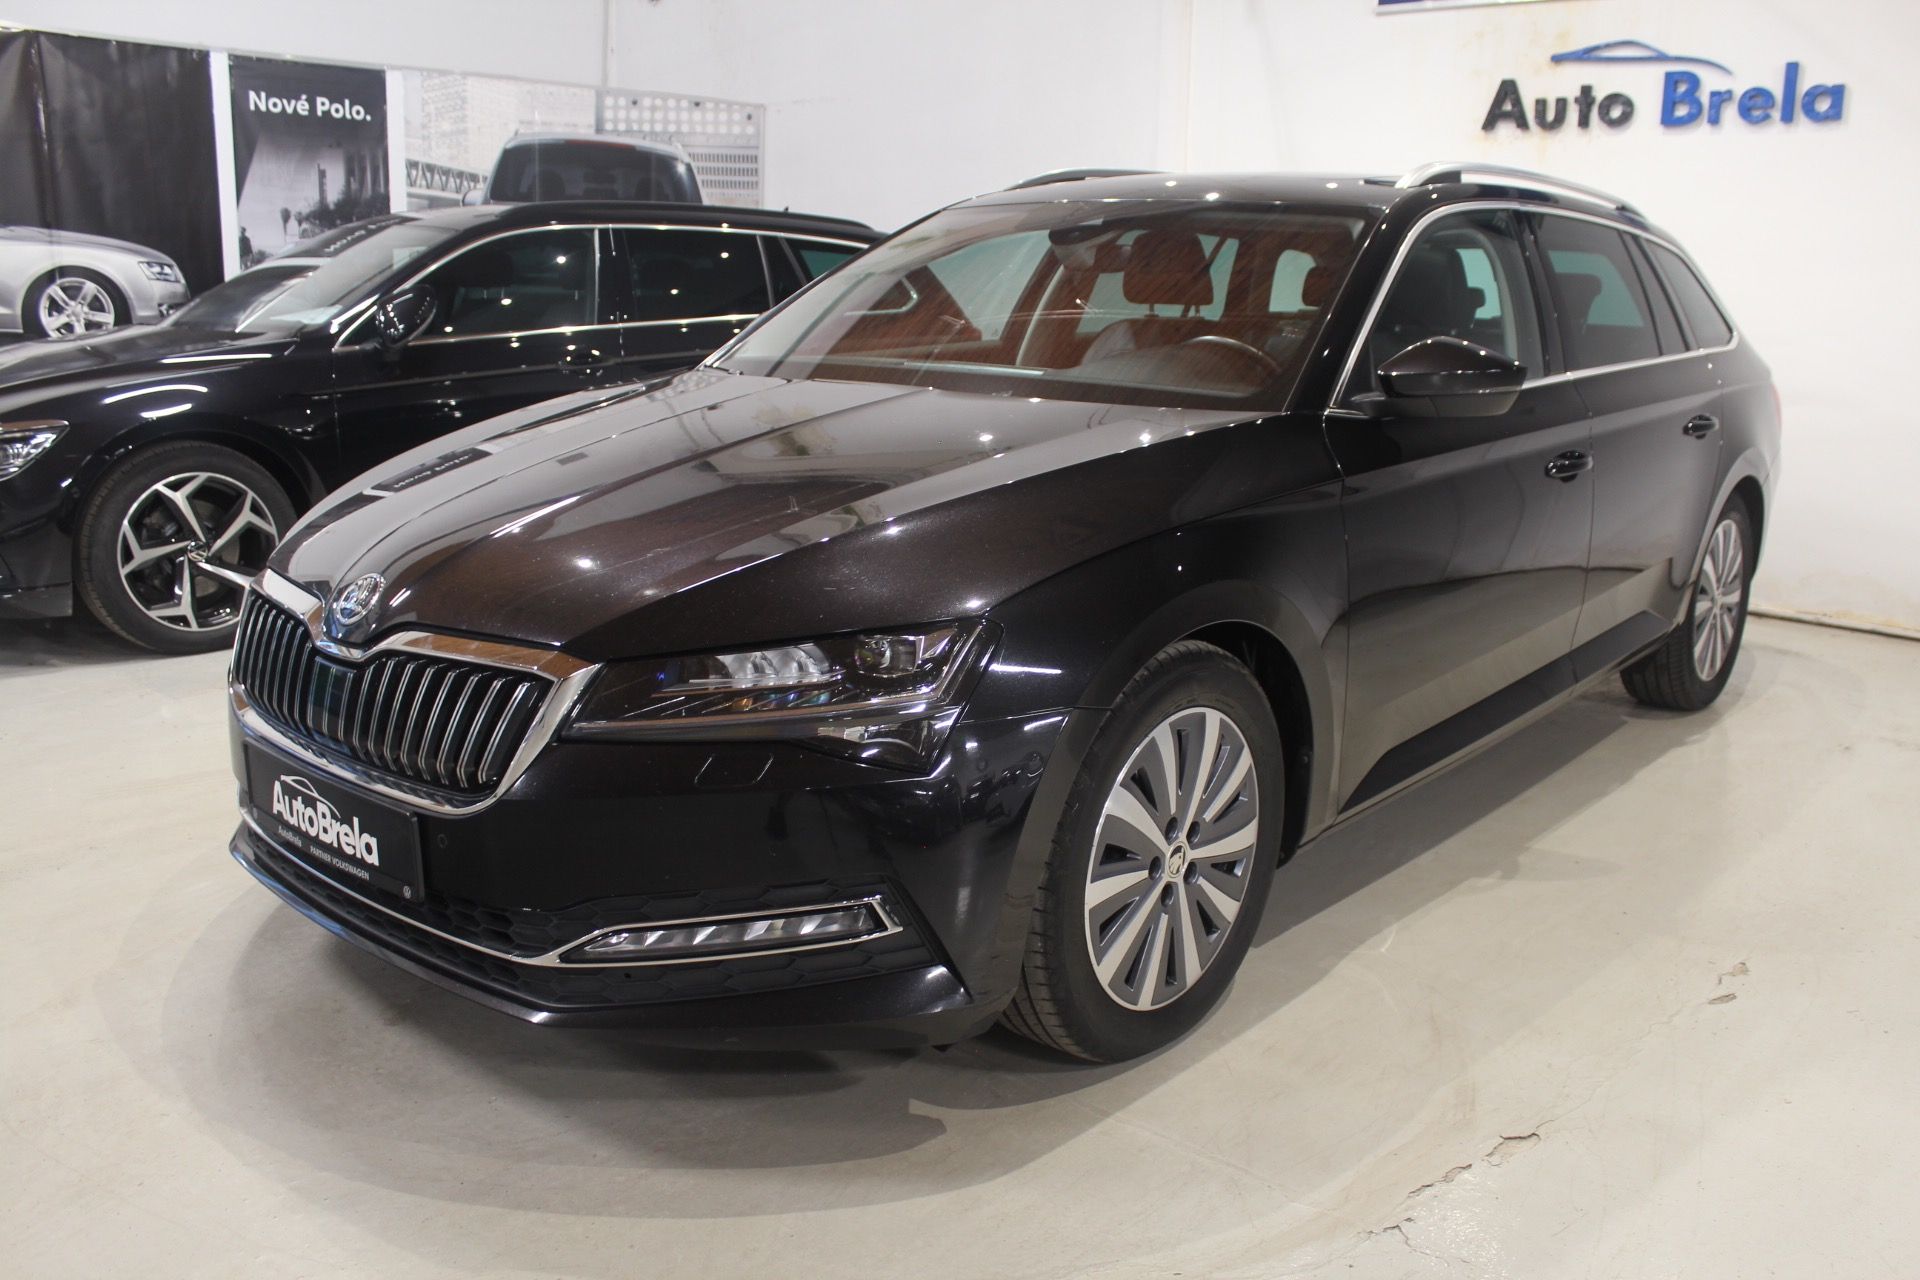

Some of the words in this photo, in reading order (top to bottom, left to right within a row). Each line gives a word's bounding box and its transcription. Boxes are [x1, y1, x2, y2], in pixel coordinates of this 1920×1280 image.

[248, 90, 310, 116] Nové
[316, 96, 372, 122] Polo.
[1481, 79, 1635, 132] Auto
[1660, 62, 1846, 127] Brela
[273, 780, 379, 866] AutoBrela
[310, 845, 332, 864] PARTNER
[332, 858, 370, 881] VOLKSWAGEN
